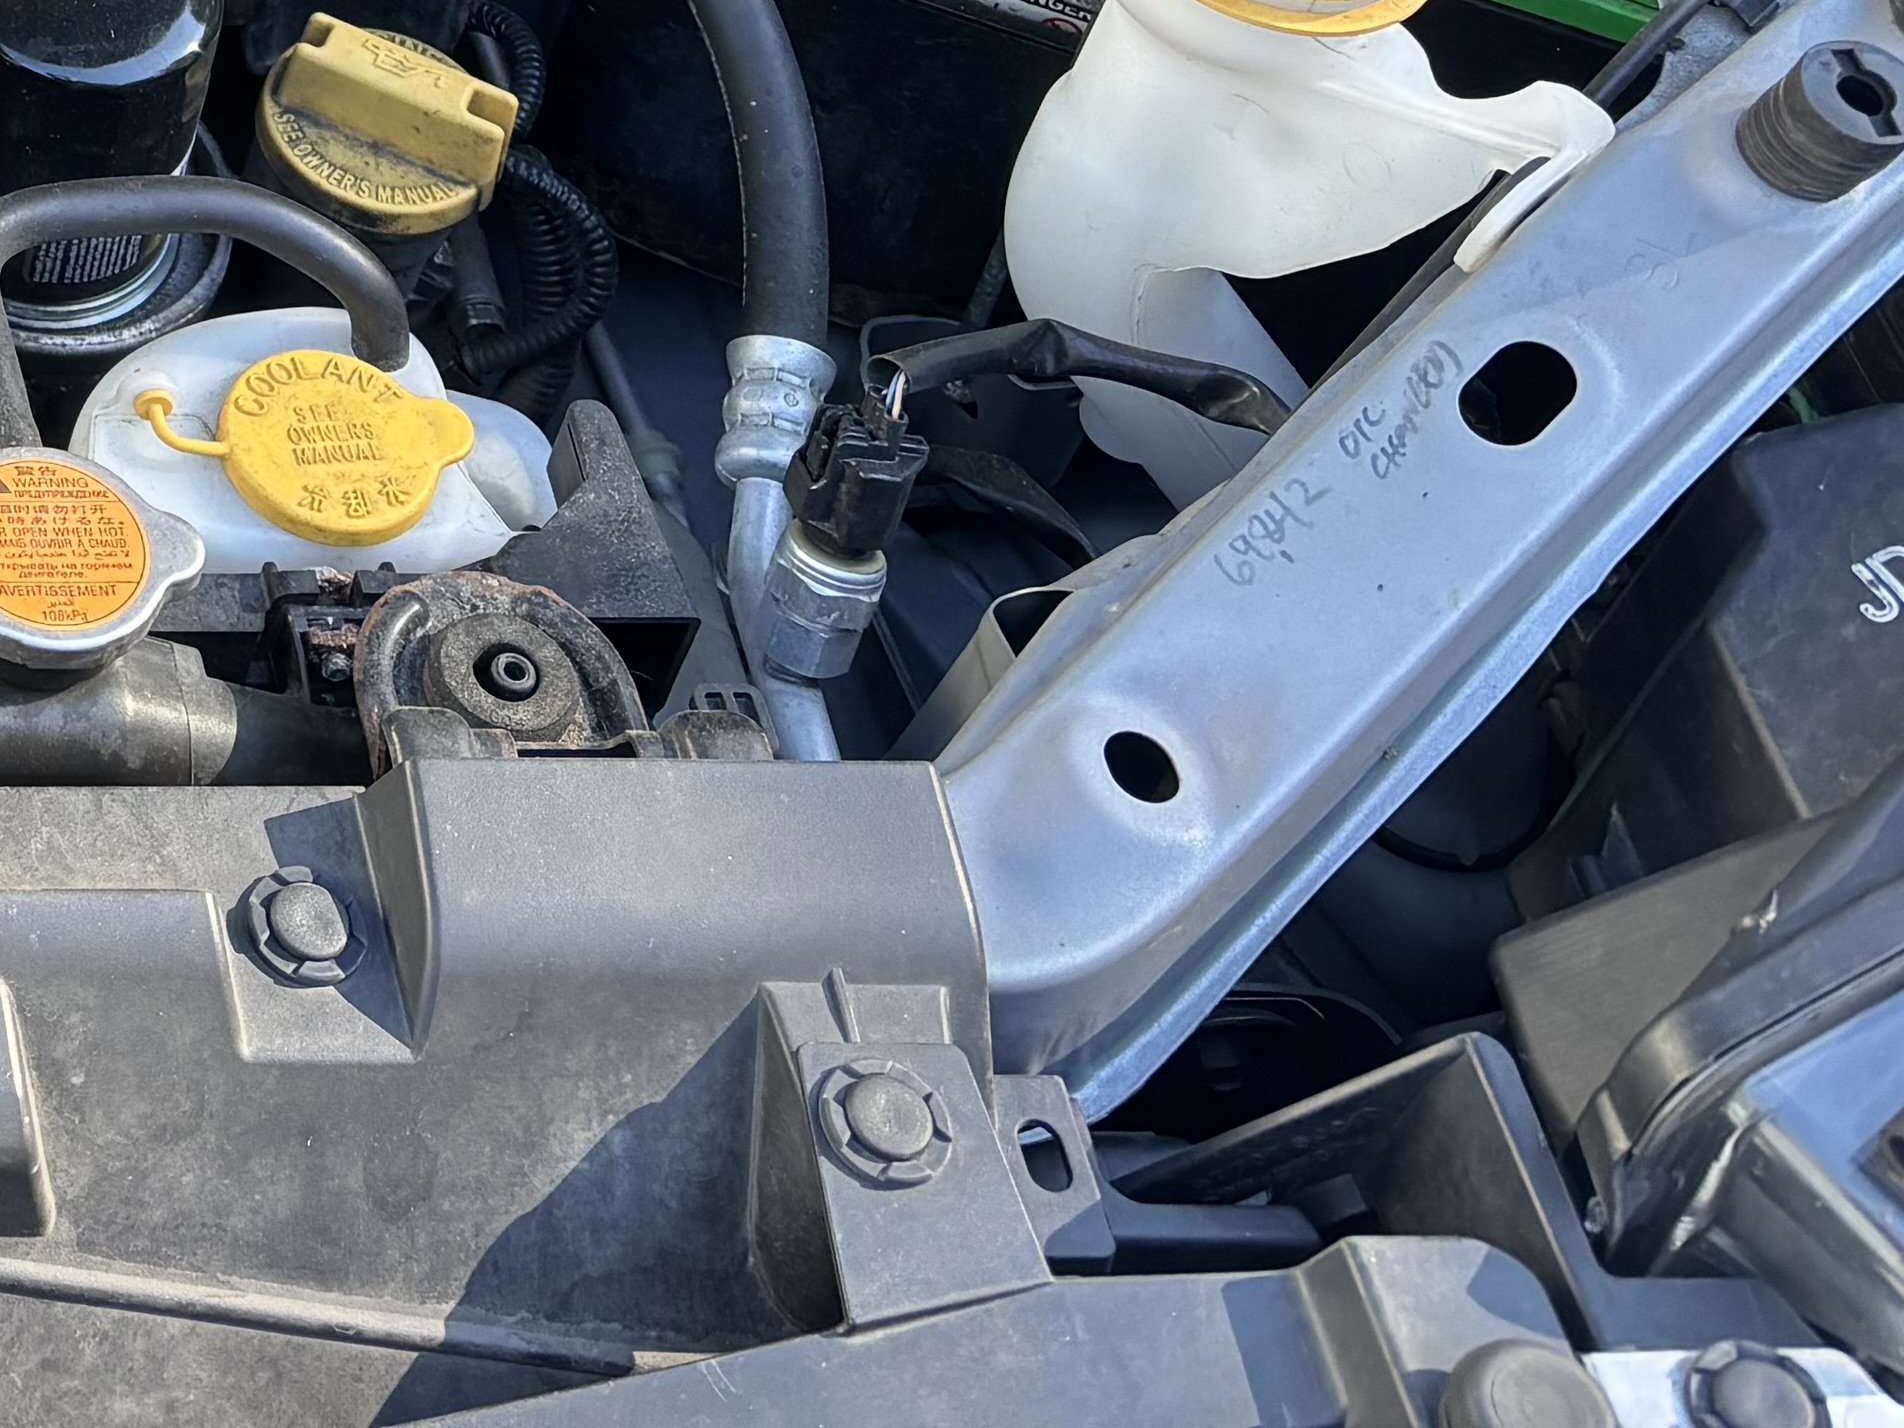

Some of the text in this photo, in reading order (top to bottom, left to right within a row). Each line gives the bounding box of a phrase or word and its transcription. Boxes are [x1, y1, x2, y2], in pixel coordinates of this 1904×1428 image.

[273, 110, 458, 206] SEE OWNER'S MANUAL
[233, 356, 403, 417] COOLANT
[293, 401, 340, 424] SEE
[286, 421, 375, 445] OWNERS
[292, 442, 384, 467] MANUAL
[11, 476, 89, 488] WARNING
[296, 475, 412, 518] 冷却水
[12, 526, 48, 537] OPEN
[52, 526, 93, 537] WHEN
[98, 526, 128, 537] HOT.
[29, 537, 72, 548] OUVRIR
[40, 609, 89, 622] 108kPa
